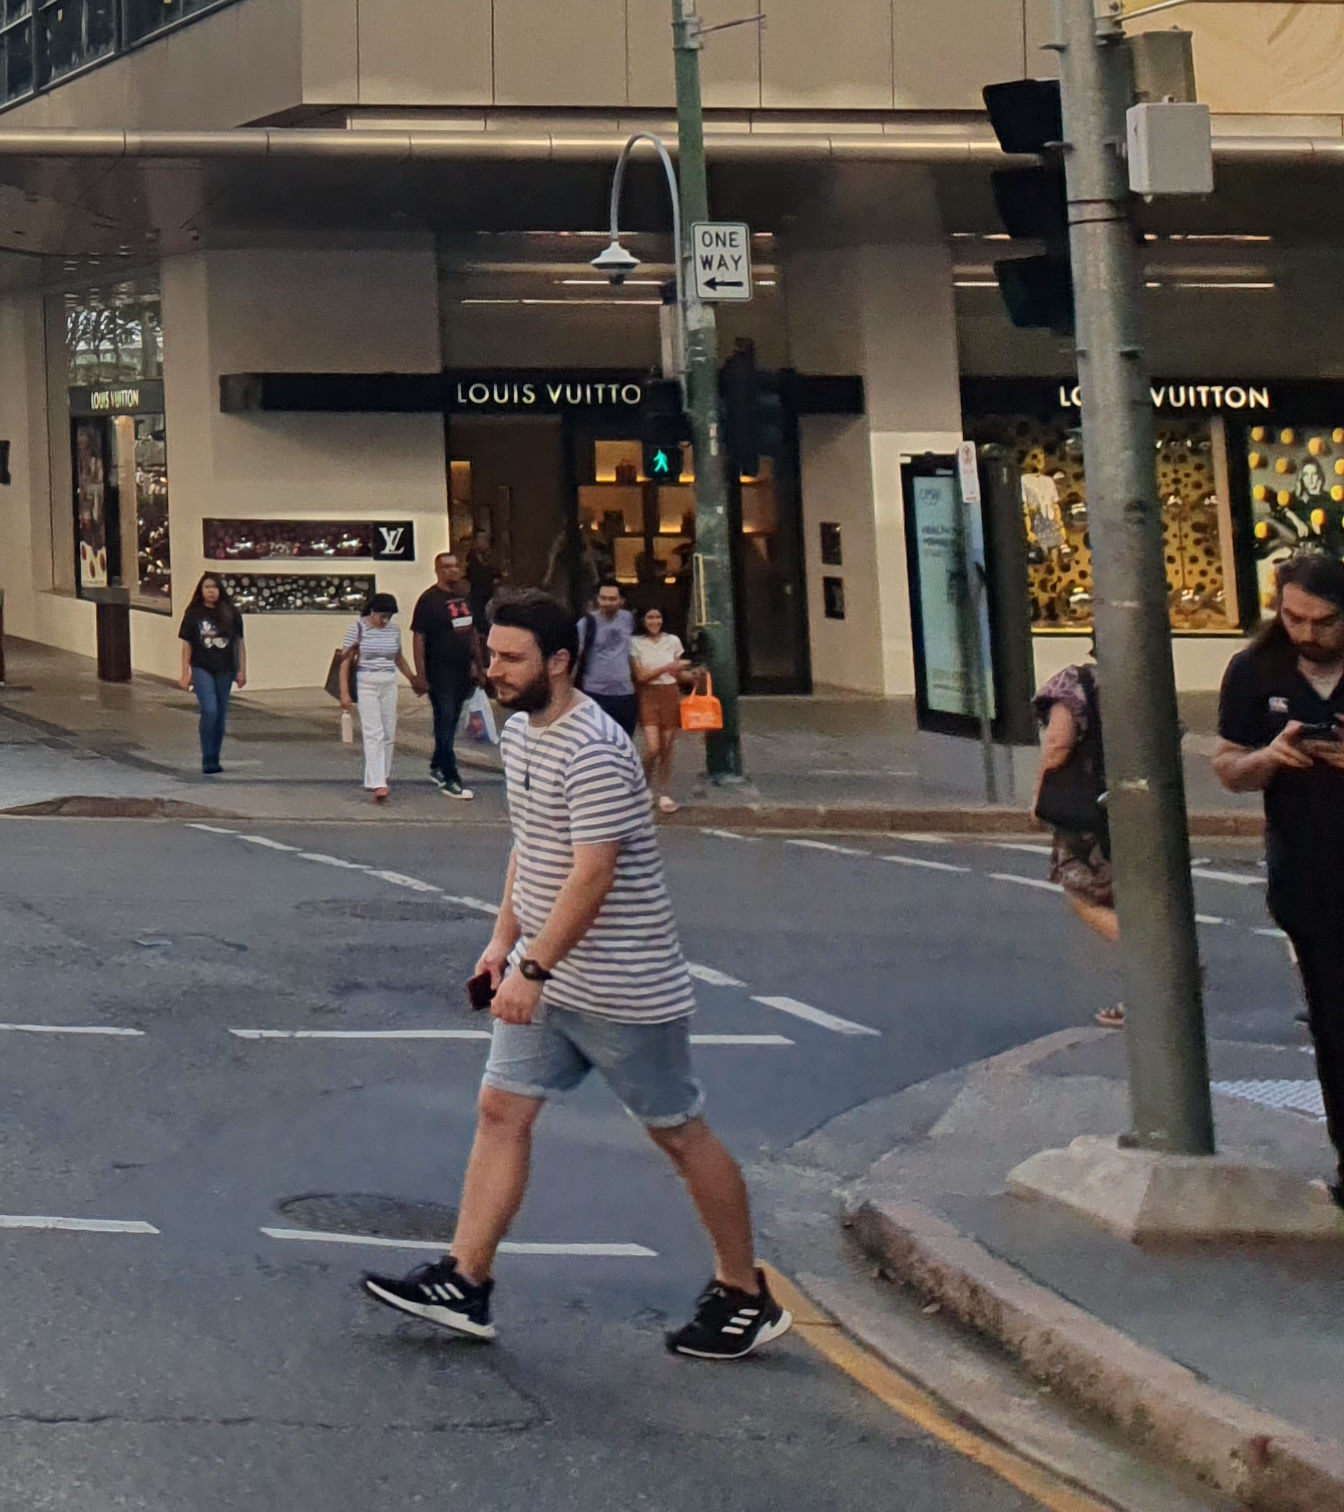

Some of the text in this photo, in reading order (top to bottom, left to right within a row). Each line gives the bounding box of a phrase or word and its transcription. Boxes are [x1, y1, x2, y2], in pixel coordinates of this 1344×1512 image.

[701, 231, 740, 248] ONE
[699, 253, 743, 272] WAY
[91, 389, 140, 409] LOUIS VUITTON
[457, 383, 641, 404] LOUIS VUITTO
[1150, 385, 1270, 408] VUITTON
